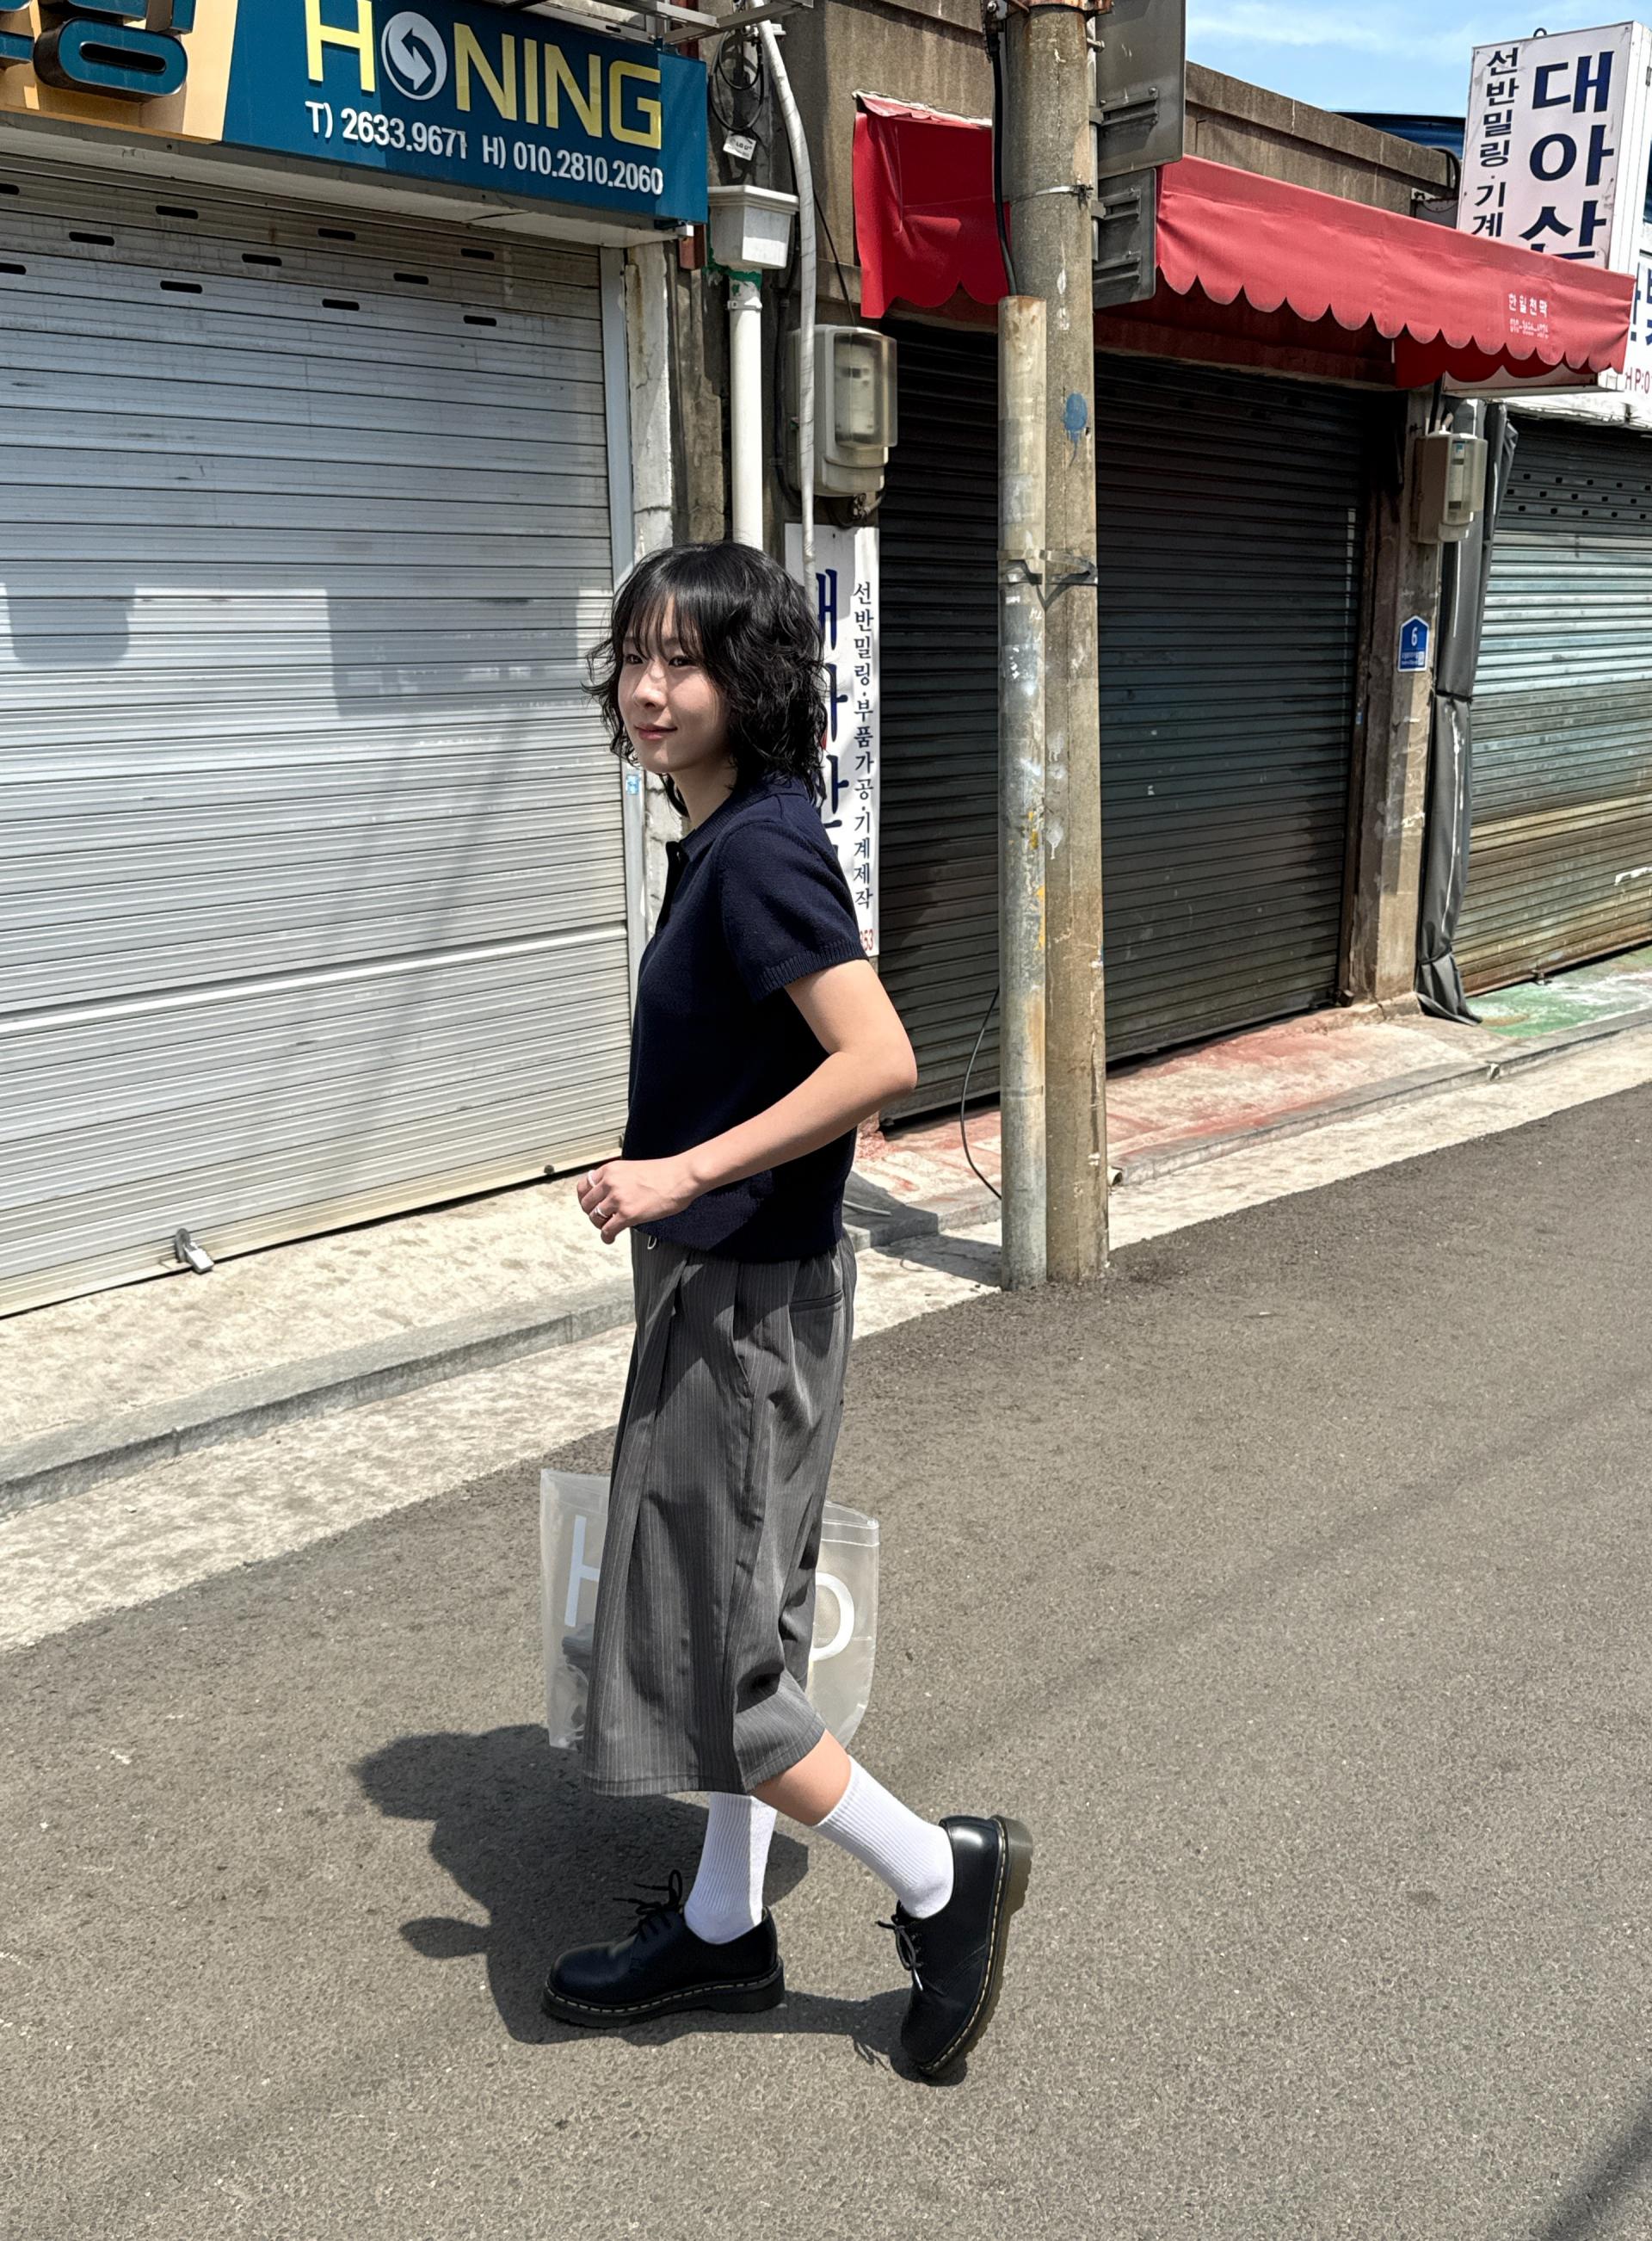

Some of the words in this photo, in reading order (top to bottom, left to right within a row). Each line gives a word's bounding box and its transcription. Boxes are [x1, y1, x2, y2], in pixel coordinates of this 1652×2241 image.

[305, 0, 662, 150] HONING
[305, 101, 333, 139] T)
[341, 108, 467, 159] 2633.9671
[482, 134, 506, 169] H)
[513, 141, 663, 195] 010.2810.2060
[1625, 366, 1652, 394] HP:0
[1411, 627, 1418, 647] 6
